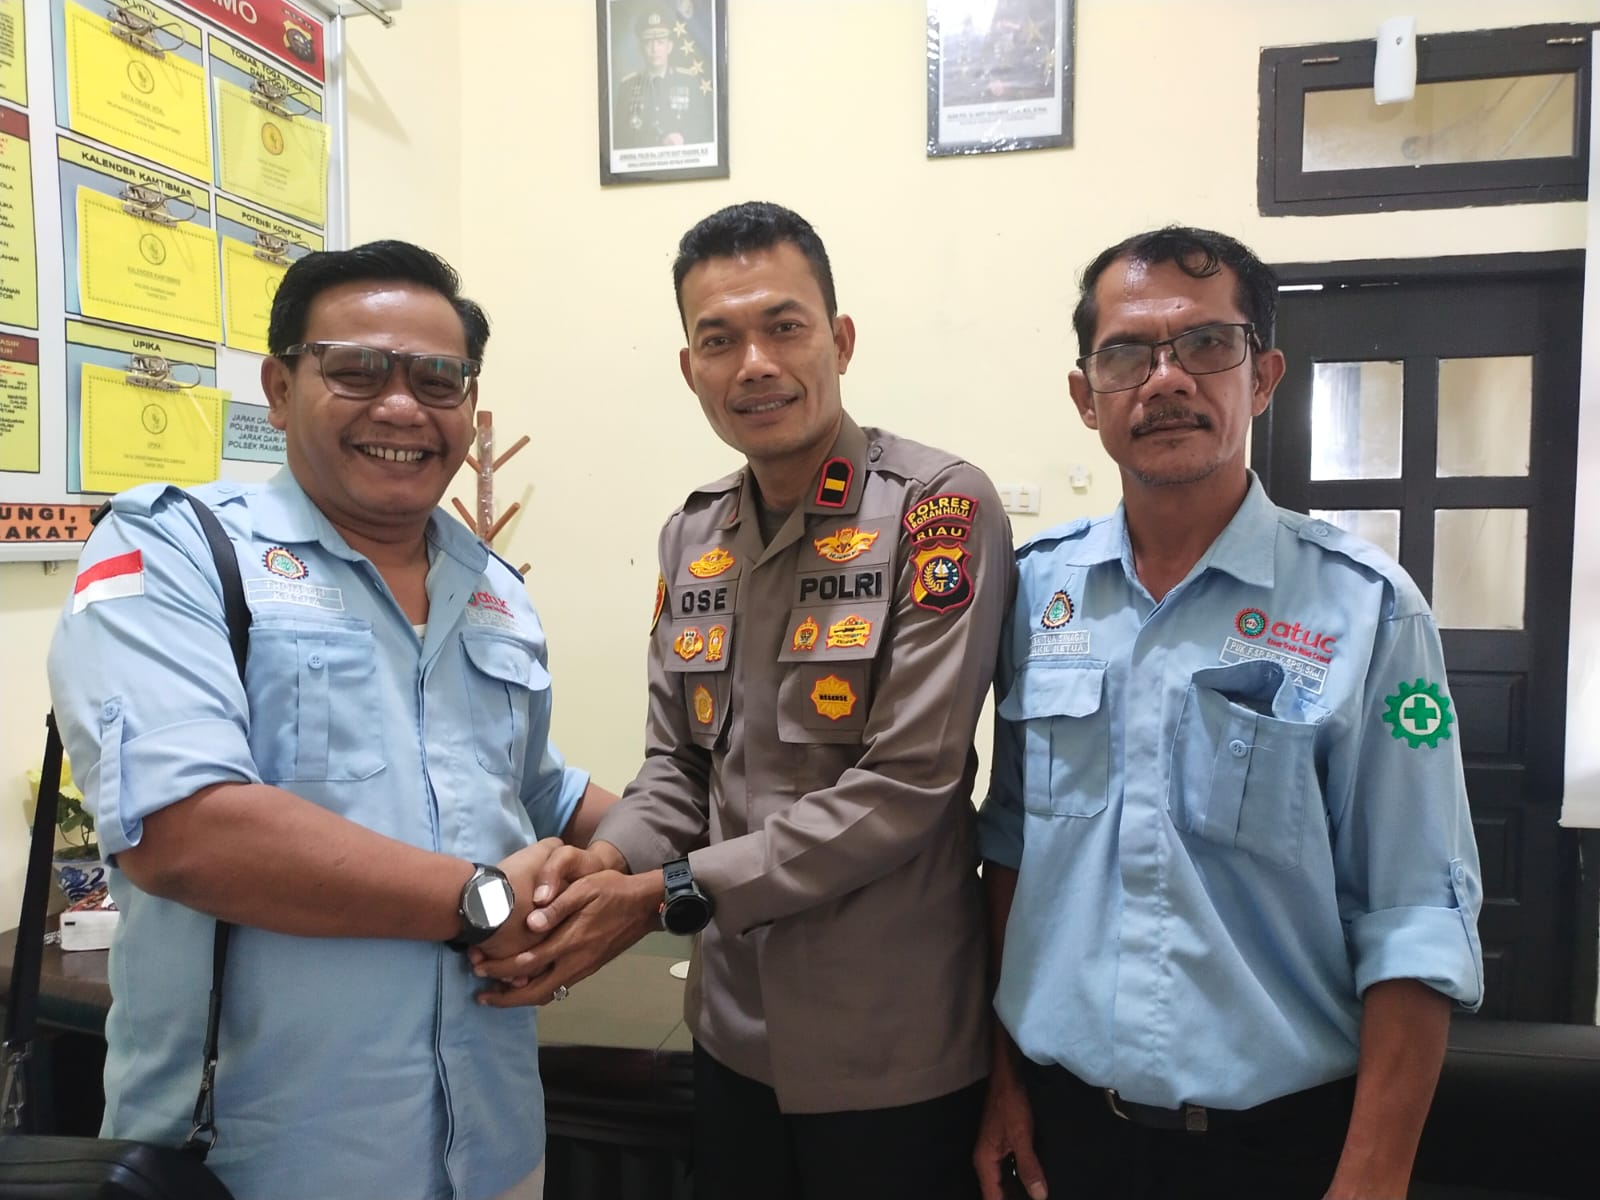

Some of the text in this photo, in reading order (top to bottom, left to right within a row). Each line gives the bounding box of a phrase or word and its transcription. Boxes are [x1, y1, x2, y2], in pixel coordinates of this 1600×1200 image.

[81, 152, 136, 178] KALENDER
[242, 212, 302, 240] POTENSI KONFLIK
[133, 339, 161, 352] UPIKA
[229, 423, 259, 432] POLRES
[232, 414, 256, 423] JARAK
[228, 440, 258, 450] POLSEK
[239, 433, 262, 441] JARAK
[907, 497, 970, 522] POLRES
[911, 506, 969, 528] ROKAN HULU
[0, 526, 77, 539] AKAT
[916, 526, 962, 541] RIAU
[799, 571, 882, 602] POLRI
[681, 588, 728, 613] OSE
[1271, 621, 1336, 654] atuc
